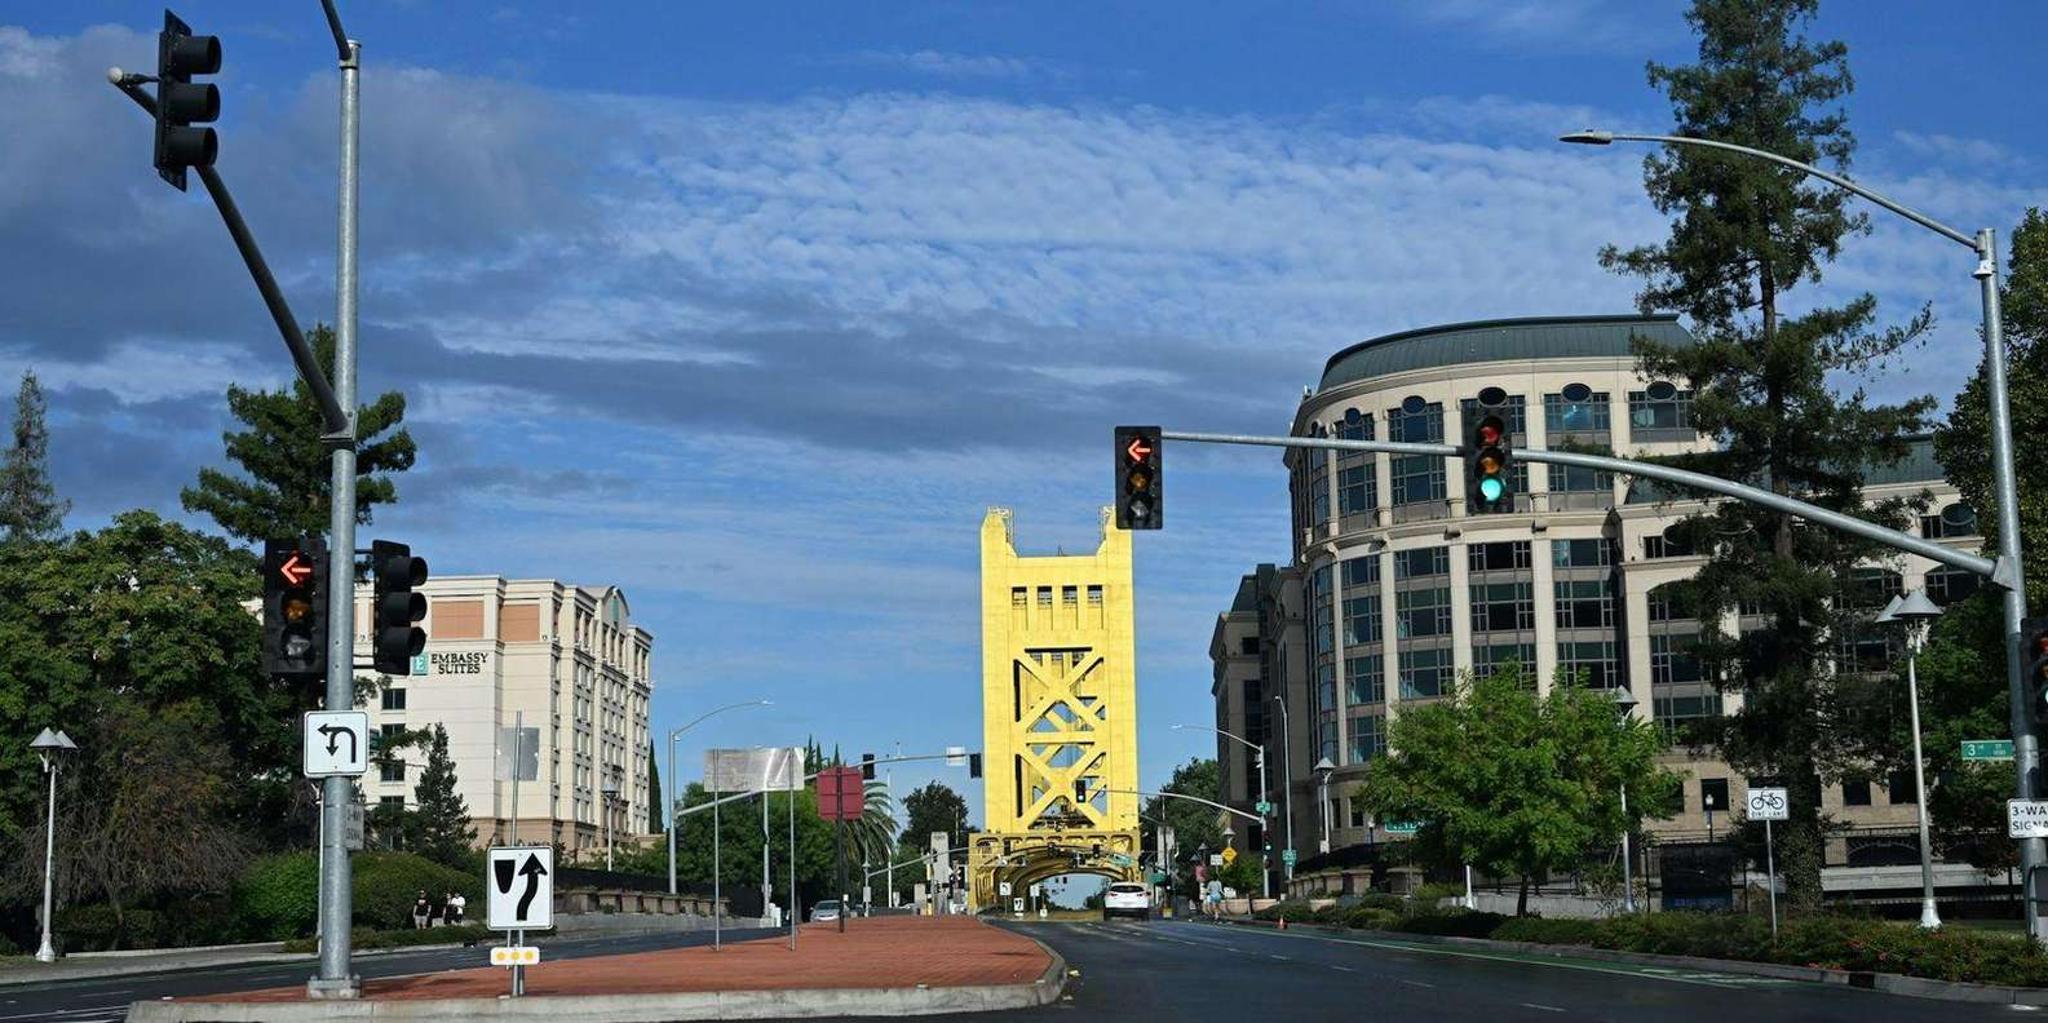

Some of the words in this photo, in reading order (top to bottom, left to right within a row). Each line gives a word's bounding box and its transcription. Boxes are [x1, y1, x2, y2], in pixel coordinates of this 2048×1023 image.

[431, 652, 488, 664] EMBASSY
[438, 663, 480, 674] SUITES
[2012, 806, 2048, 816] 3-WA
[2012, 821, 2048, 830] SIGNA
